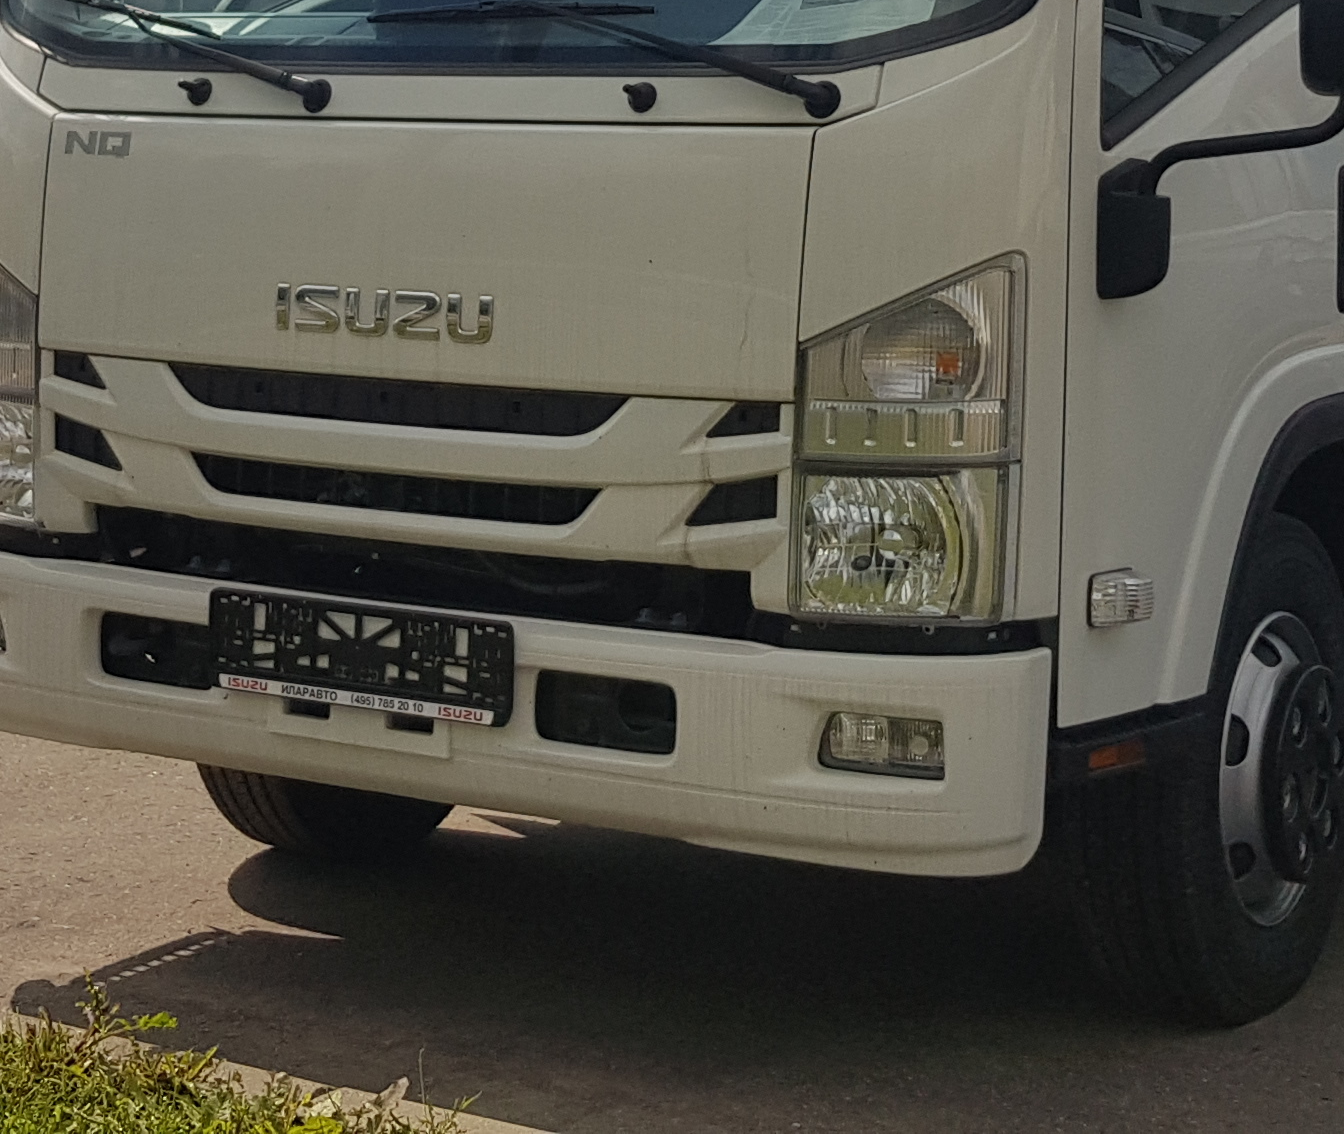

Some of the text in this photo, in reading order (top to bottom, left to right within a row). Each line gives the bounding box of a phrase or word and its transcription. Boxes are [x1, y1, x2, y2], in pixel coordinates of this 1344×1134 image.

[64, 131, 132, 159] NQ
[276, 282, 494, 344] ISUZU
[227, 677, 268, 691] ISUZU
[281, 684, 423, 713] ИЛАРАВТО (495) 785 20 10
[438, 706, 483, 722] ISUZU
